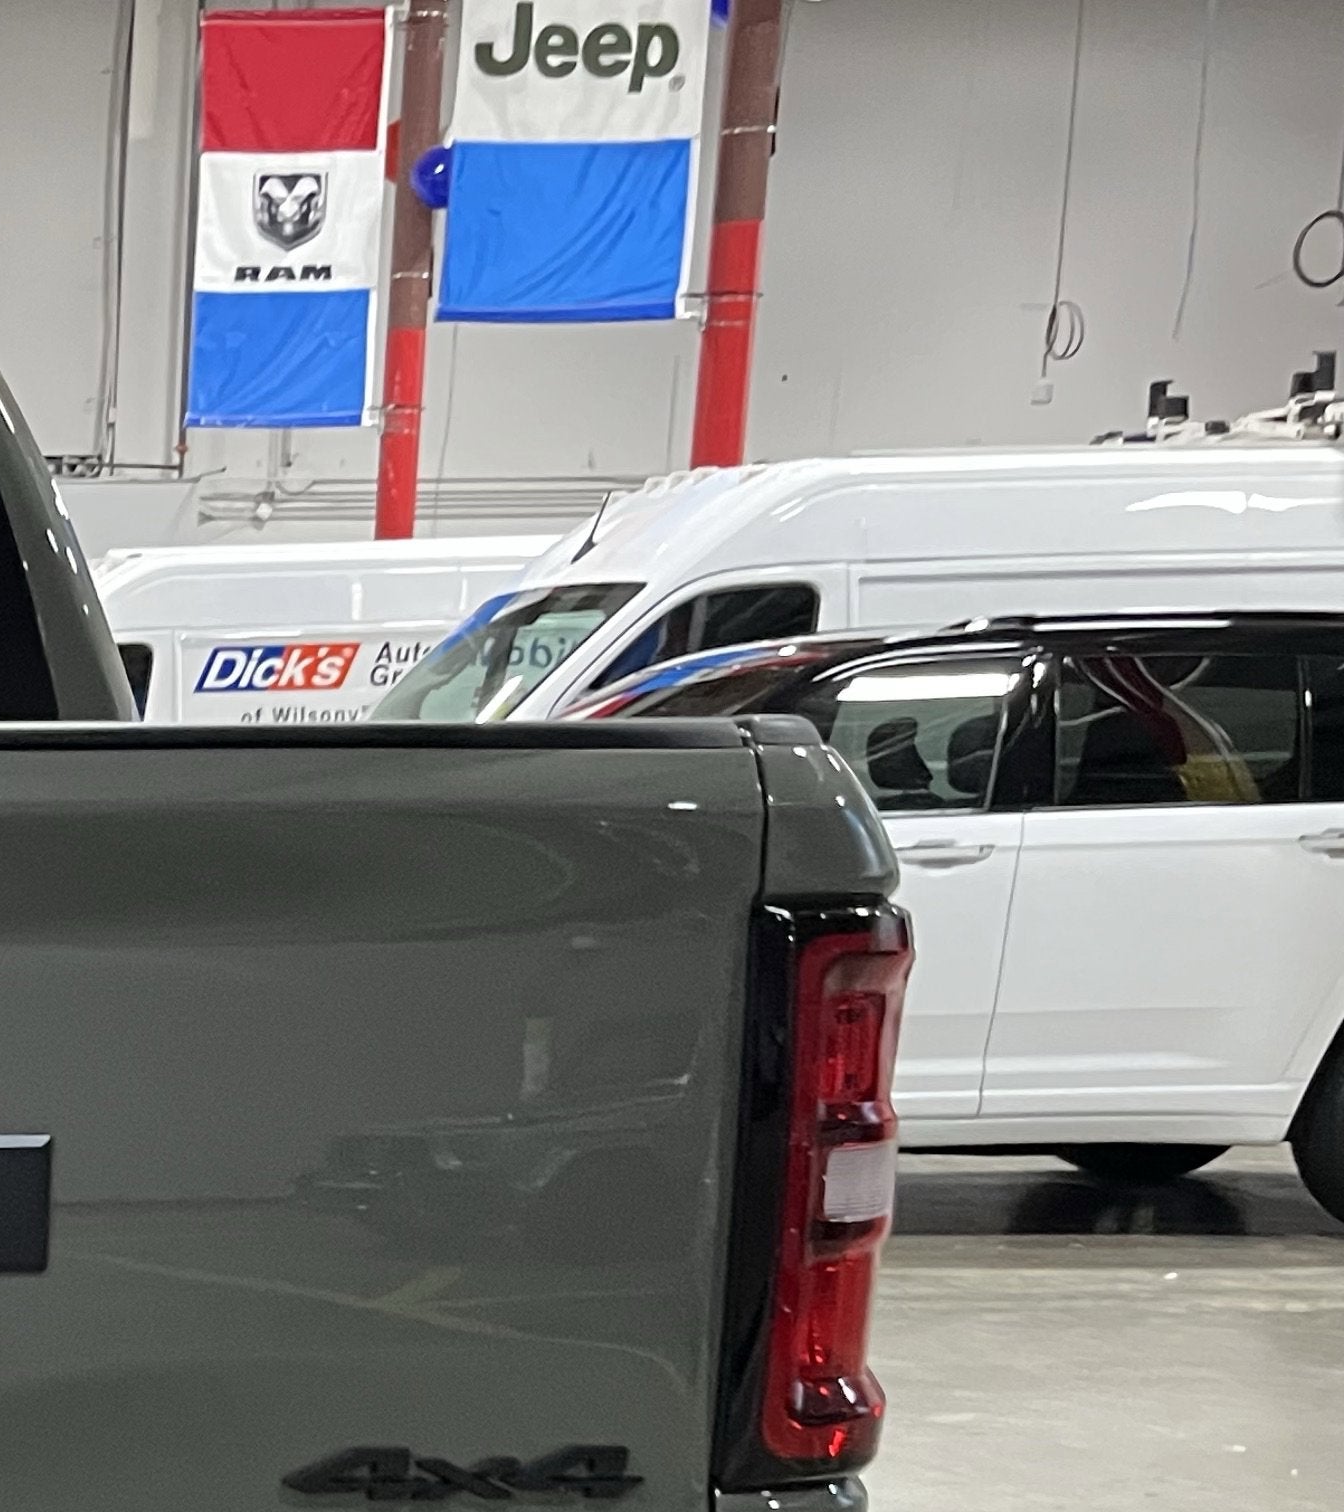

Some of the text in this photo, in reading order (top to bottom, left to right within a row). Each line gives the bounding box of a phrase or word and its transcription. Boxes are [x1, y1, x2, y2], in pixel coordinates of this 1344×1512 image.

[475, 2, 681, 93] Jeep
[234, 265, 332, 282] RAM
[200, 646, 346, 689] Dick's
